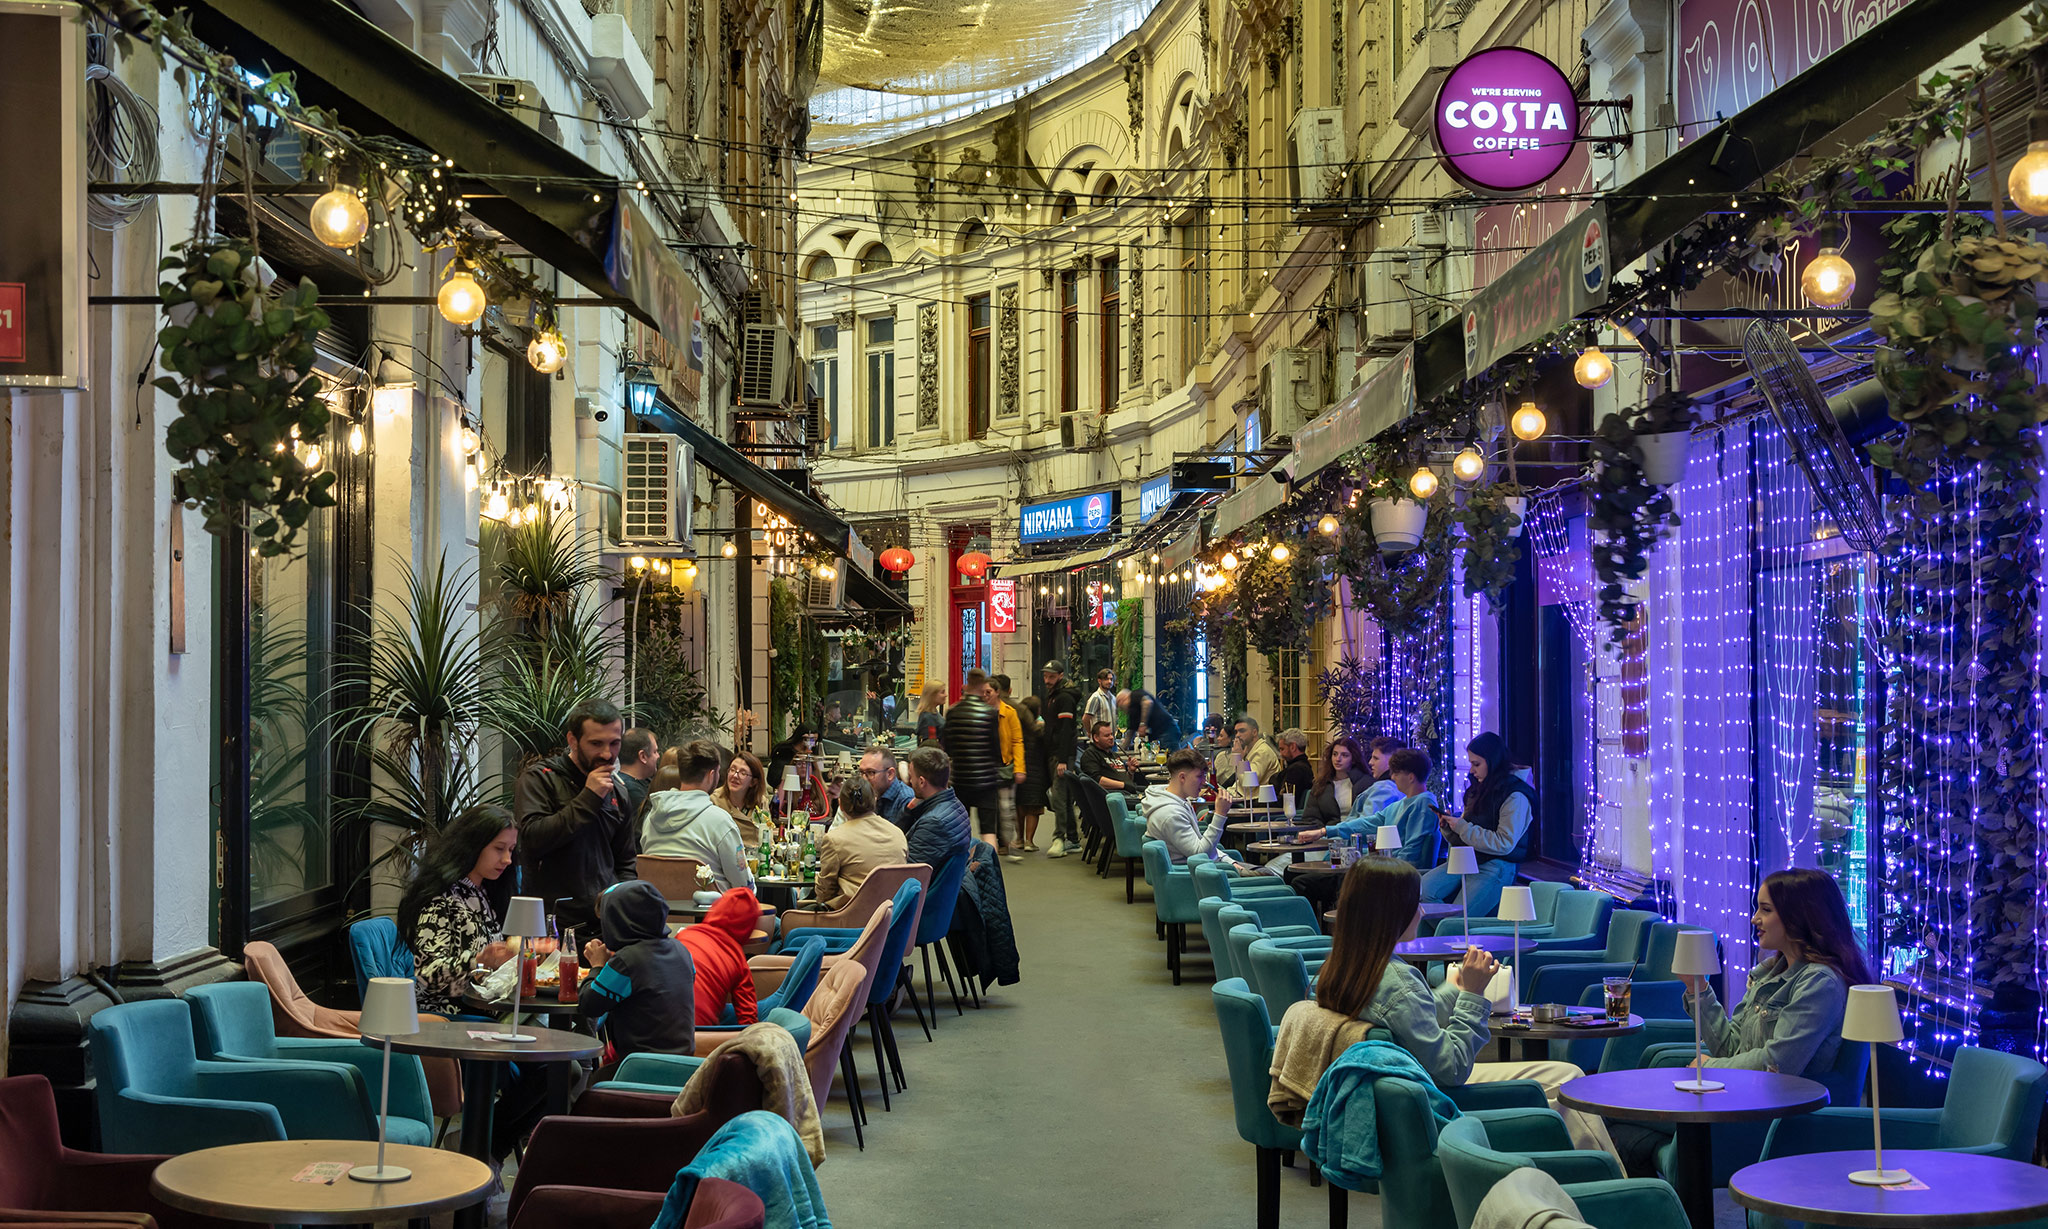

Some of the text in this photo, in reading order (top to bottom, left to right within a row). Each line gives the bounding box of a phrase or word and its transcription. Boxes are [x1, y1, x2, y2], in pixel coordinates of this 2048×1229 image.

[1472, 87, 1542, 97] WE'RE SERVING
[1445, 100, 1568, 133] COSTA
[1473, 136, 1540, 150] COFFEE
[1141, 482, 1171, 517] NIRVANA
[1024, 505, 1073, 535] NIRVANA
